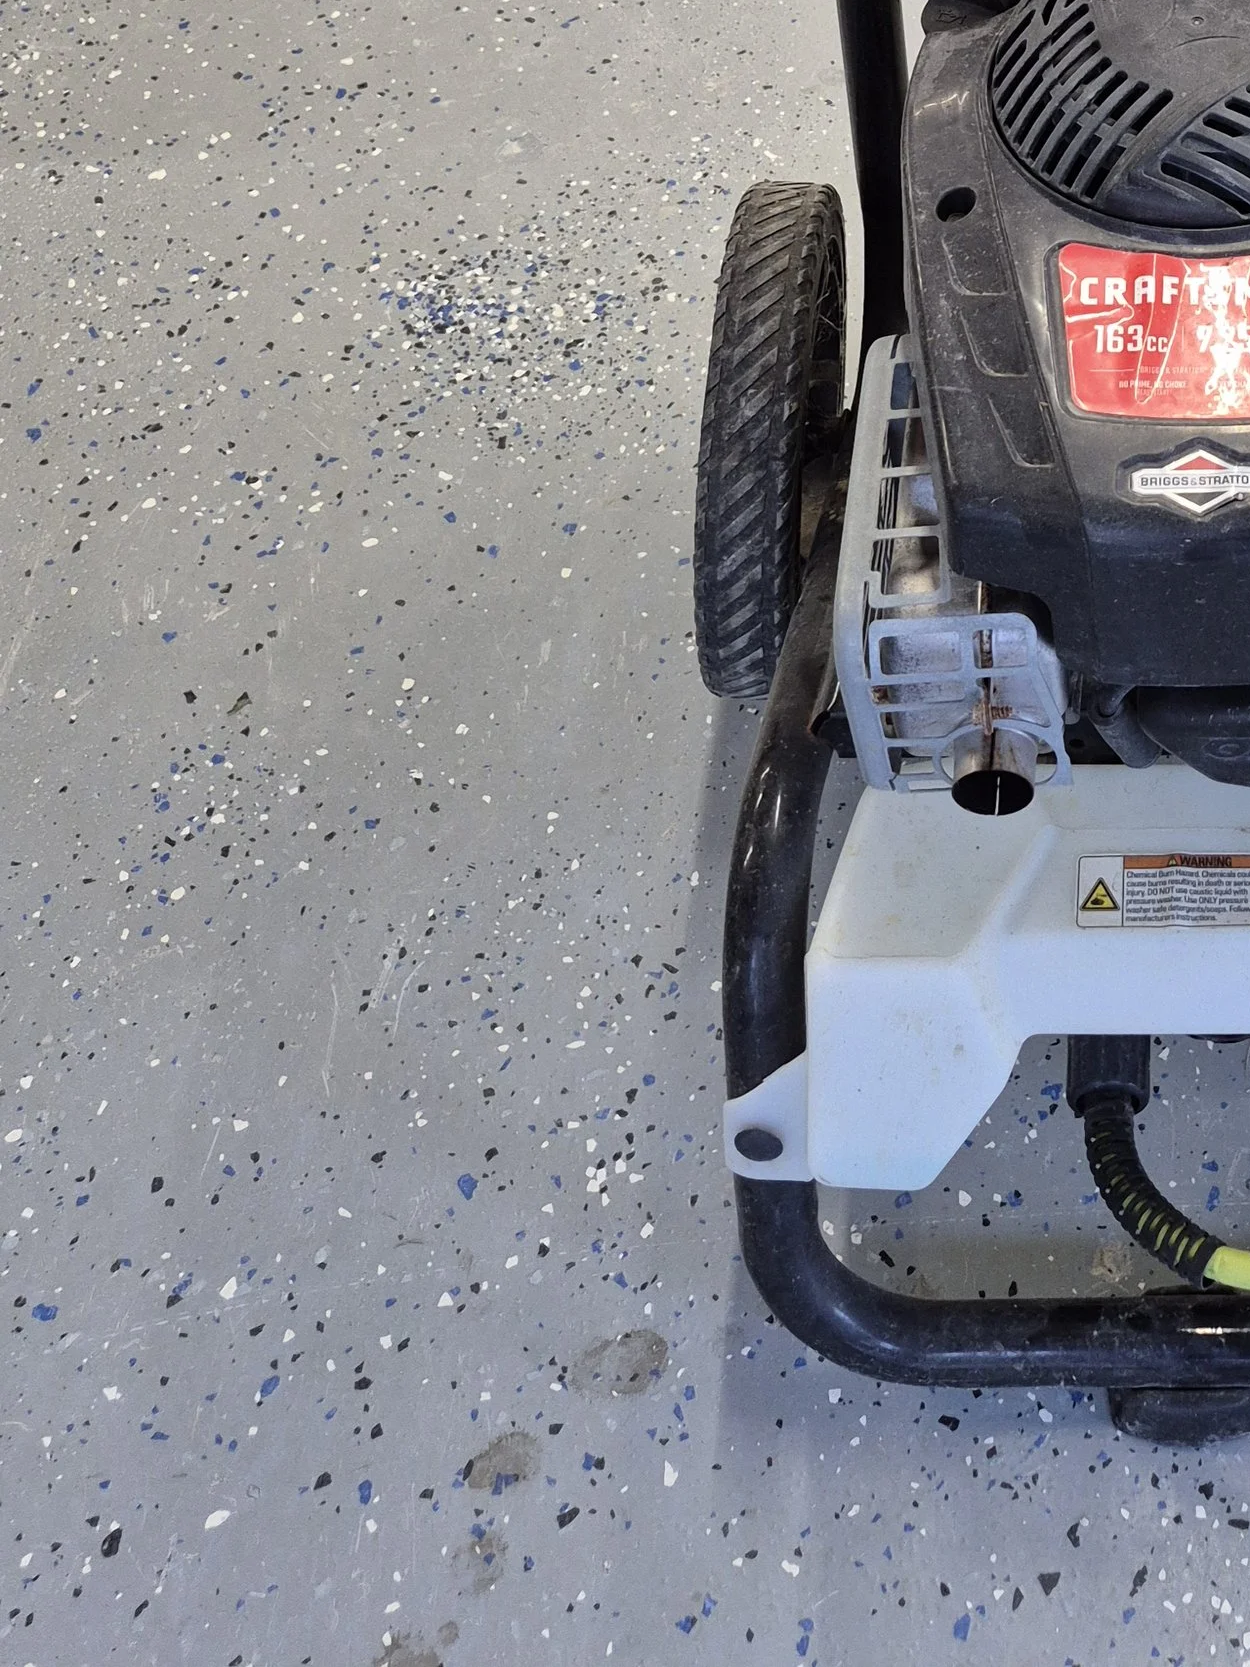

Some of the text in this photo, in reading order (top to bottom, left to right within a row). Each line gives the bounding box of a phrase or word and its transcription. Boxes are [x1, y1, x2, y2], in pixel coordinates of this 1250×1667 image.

[1180, 856, 1232, 868] WARNING
[1126, 870, 1157, 878] Chemical
[1158, 870, 1174, 878] Burn
[1201, 870, 1236, 878] Chemicals
[1168, 878, 1197, 888] resulting
[1205, 878, 1224, 886] death
[1147, 887, 1158, 895] DO
[1159, 886, 1174, 894] NOT
[1214, 887, 1232, 896] liquid
[1232, 888, 1248, 896] with
[1184, 895, 1197, 903] Use
[1218, 897, 1248, 905] pressure
